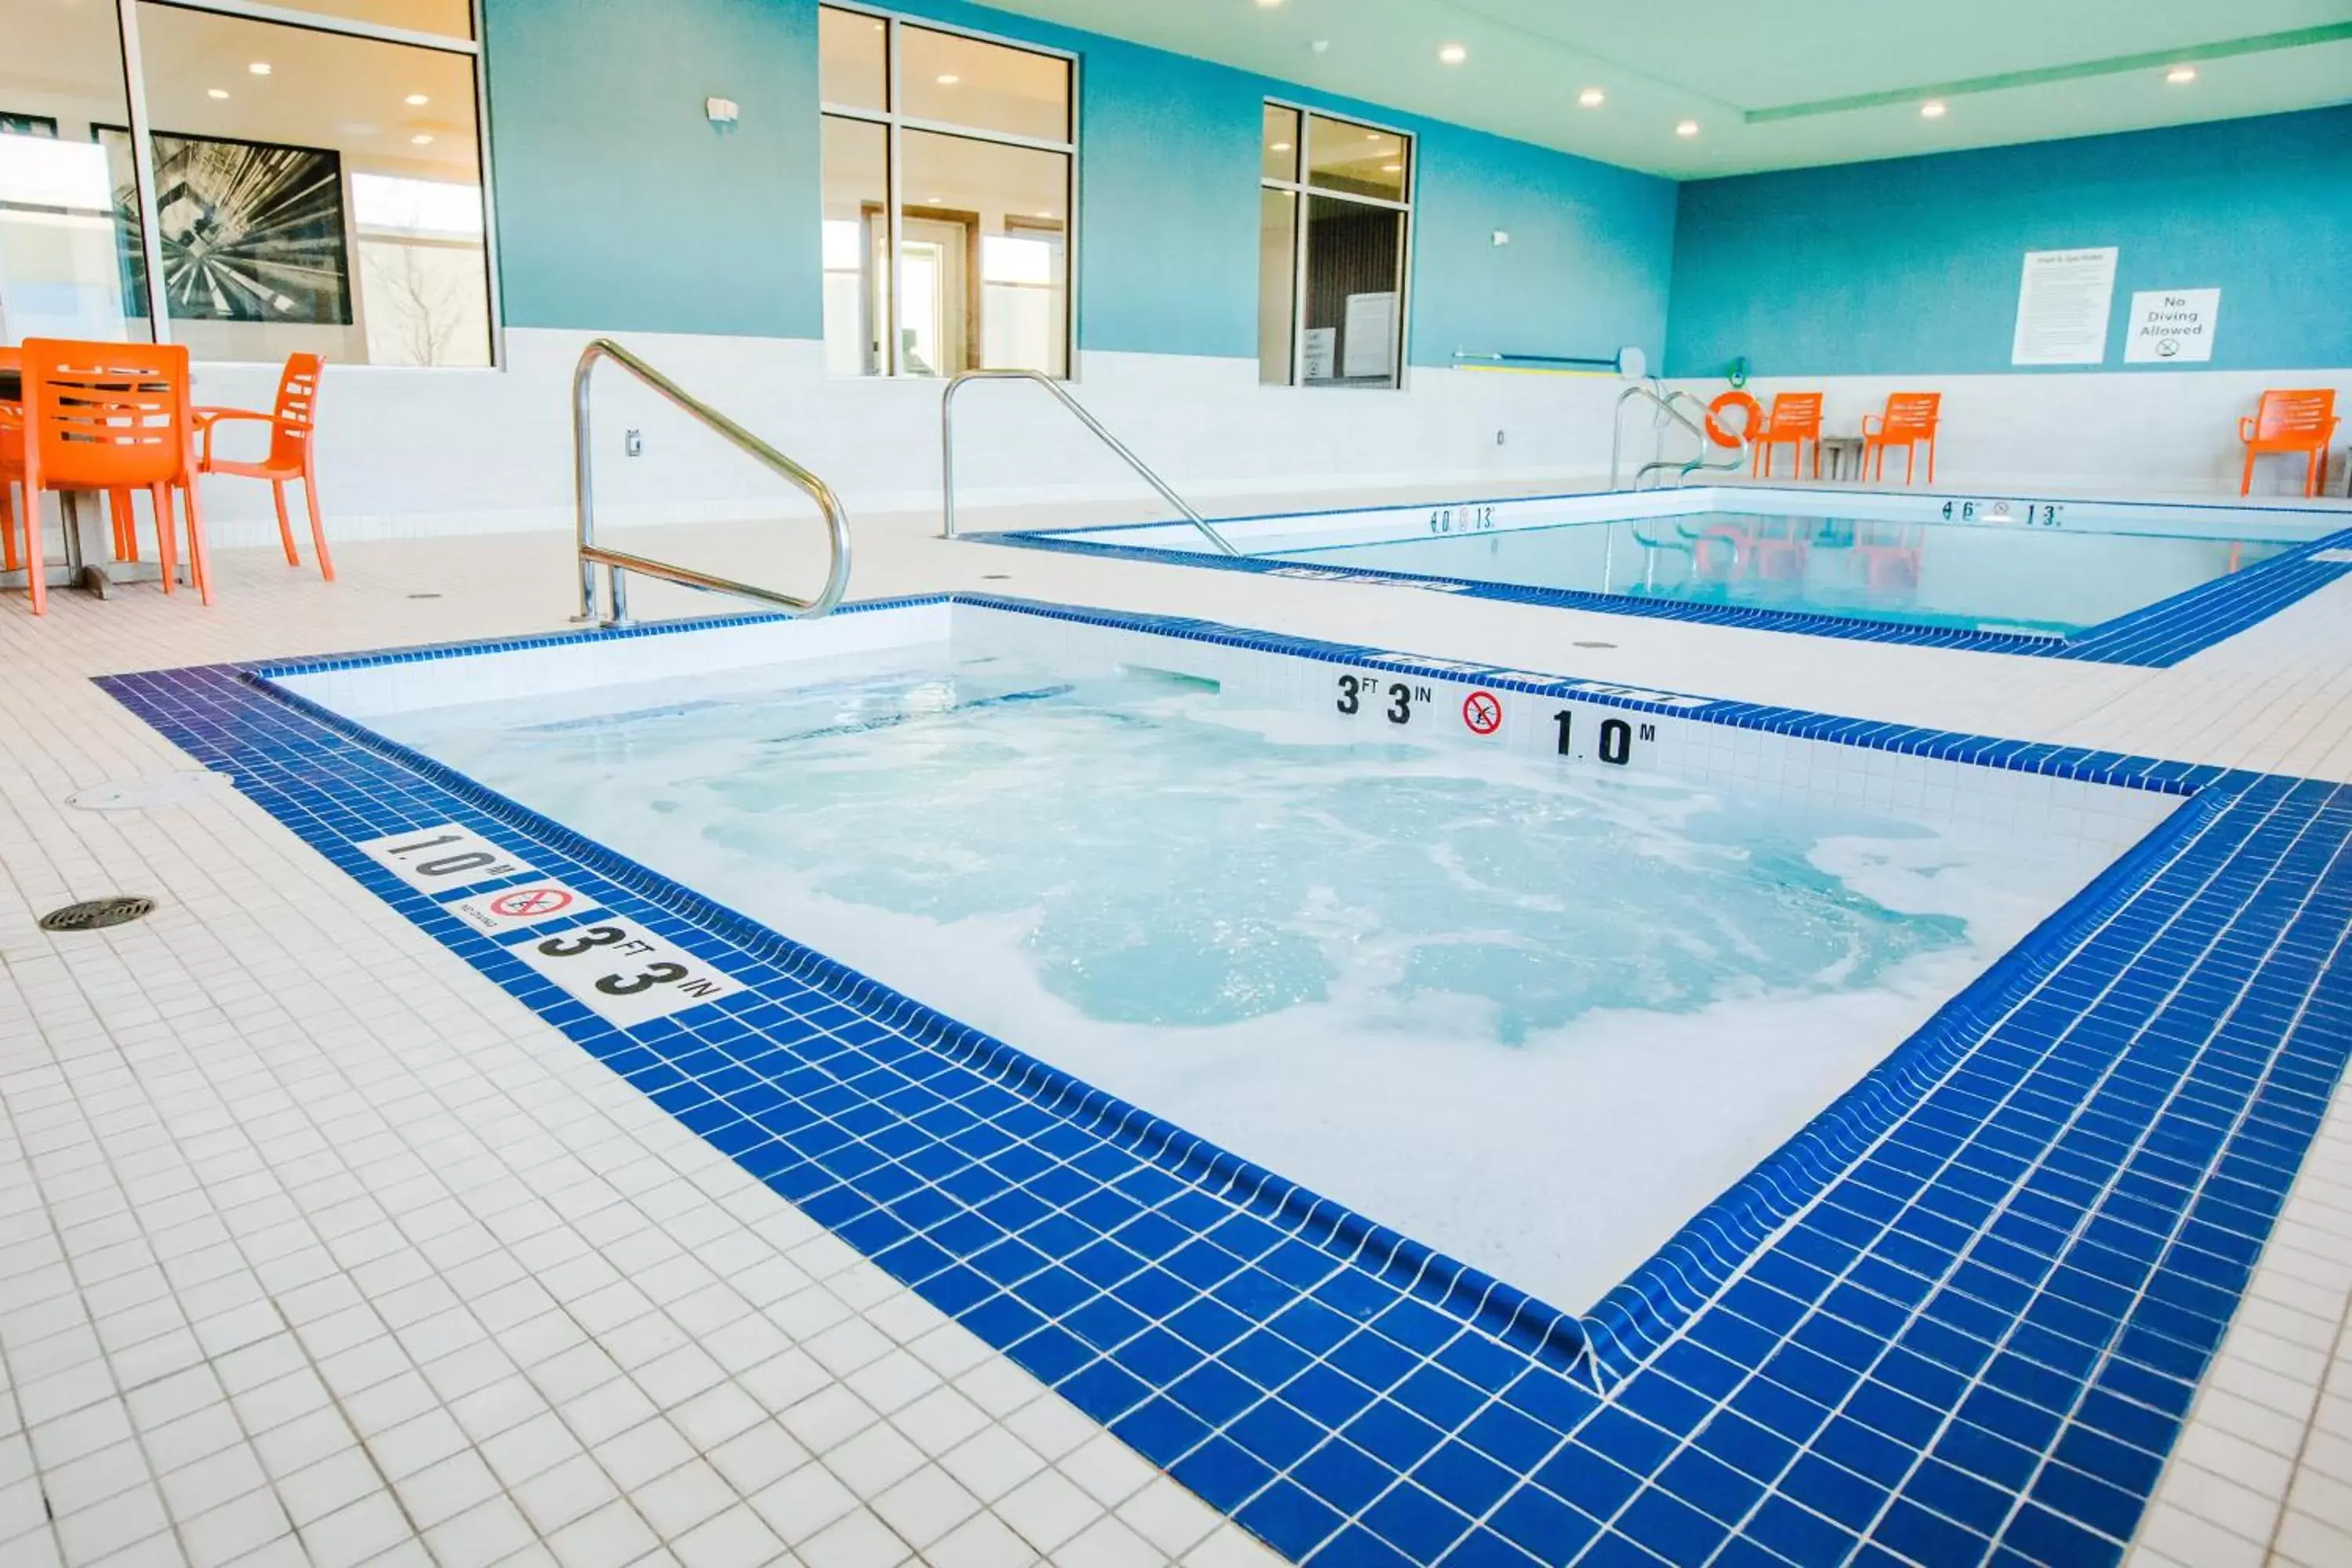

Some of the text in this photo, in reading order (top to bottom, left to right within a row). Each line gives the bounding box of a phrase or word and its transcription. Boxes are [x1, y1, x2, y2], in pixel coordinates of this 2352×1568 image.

[2164, 296, 2186, 307] No
[2147, 310, 2198, 322] Diving
[2140, 325, 2203, 337] Allowed
